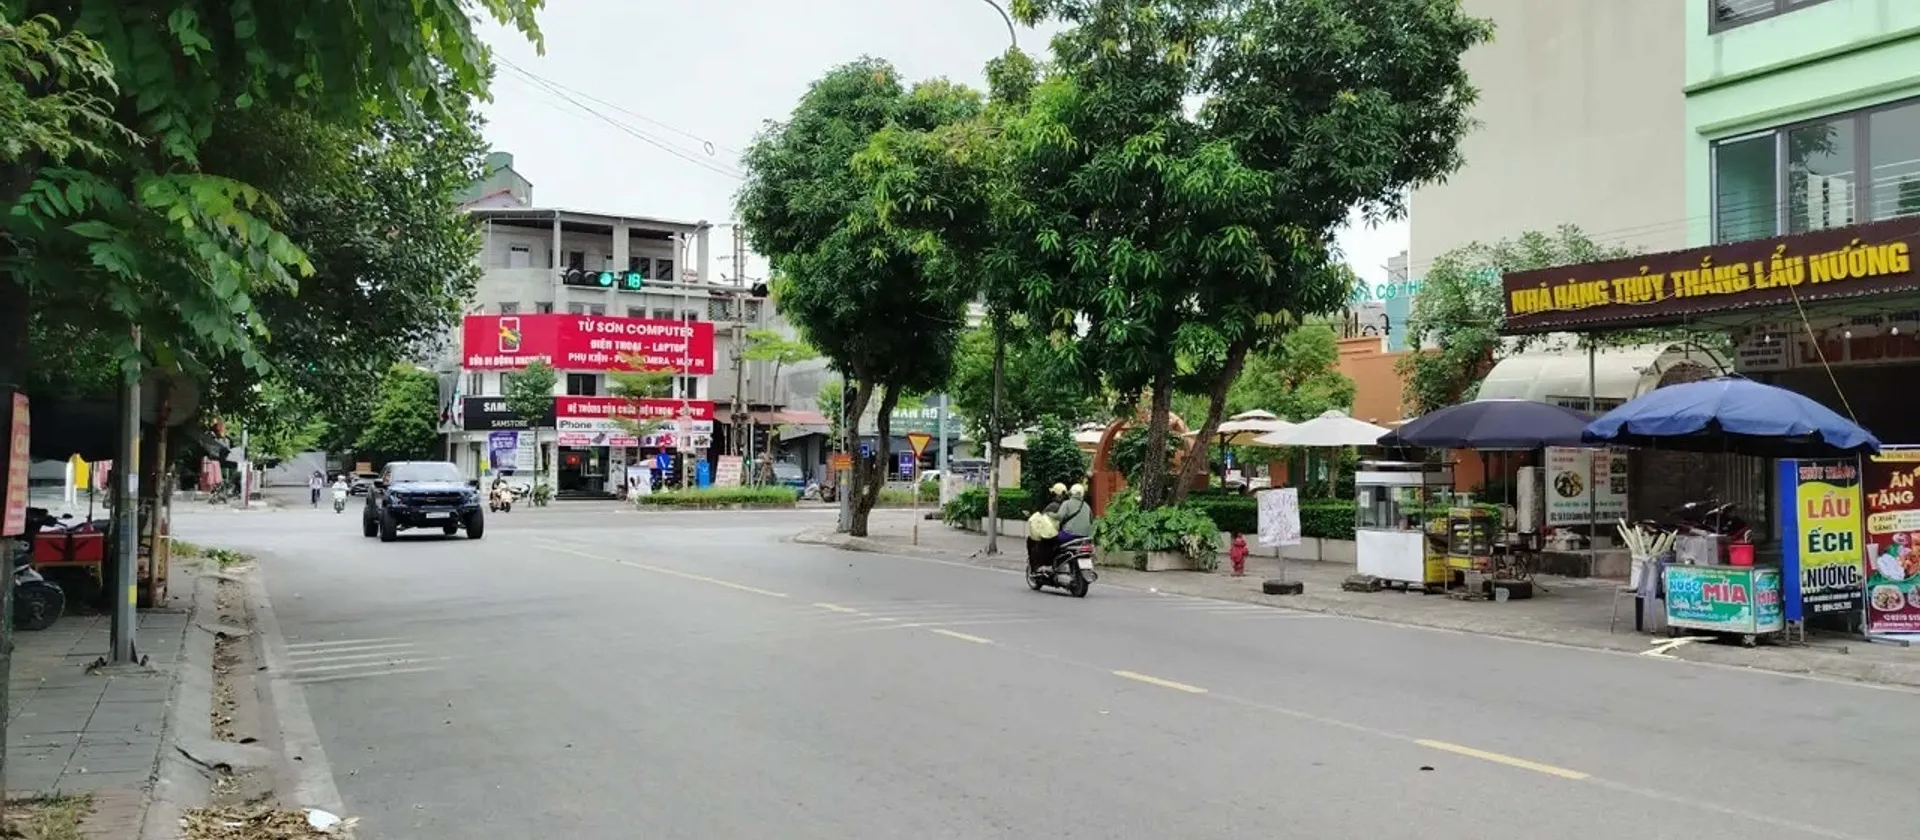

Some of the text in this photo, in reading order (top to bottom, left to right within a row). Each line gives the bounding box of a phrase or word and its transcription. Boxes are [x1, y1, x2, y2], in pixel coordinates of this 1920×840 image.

[1511, 237, 1910, 314] NHÀ HÀNG THỦY THẮNG LẨU NƯỚNG
[578, 317, 695, 337] TỪ SƠN COMPUTER
[568, 352, 586, 363] PHỤ
[1890, 471, 1914, 488] ĂN
[1867, 489, 1914, 510] TẶNG
[1808, 525, 1854, 553] ẾCH
[1807, 562, 1857, 588] NƯỚNG
[1702, 579, 1749, 604] MÍA
